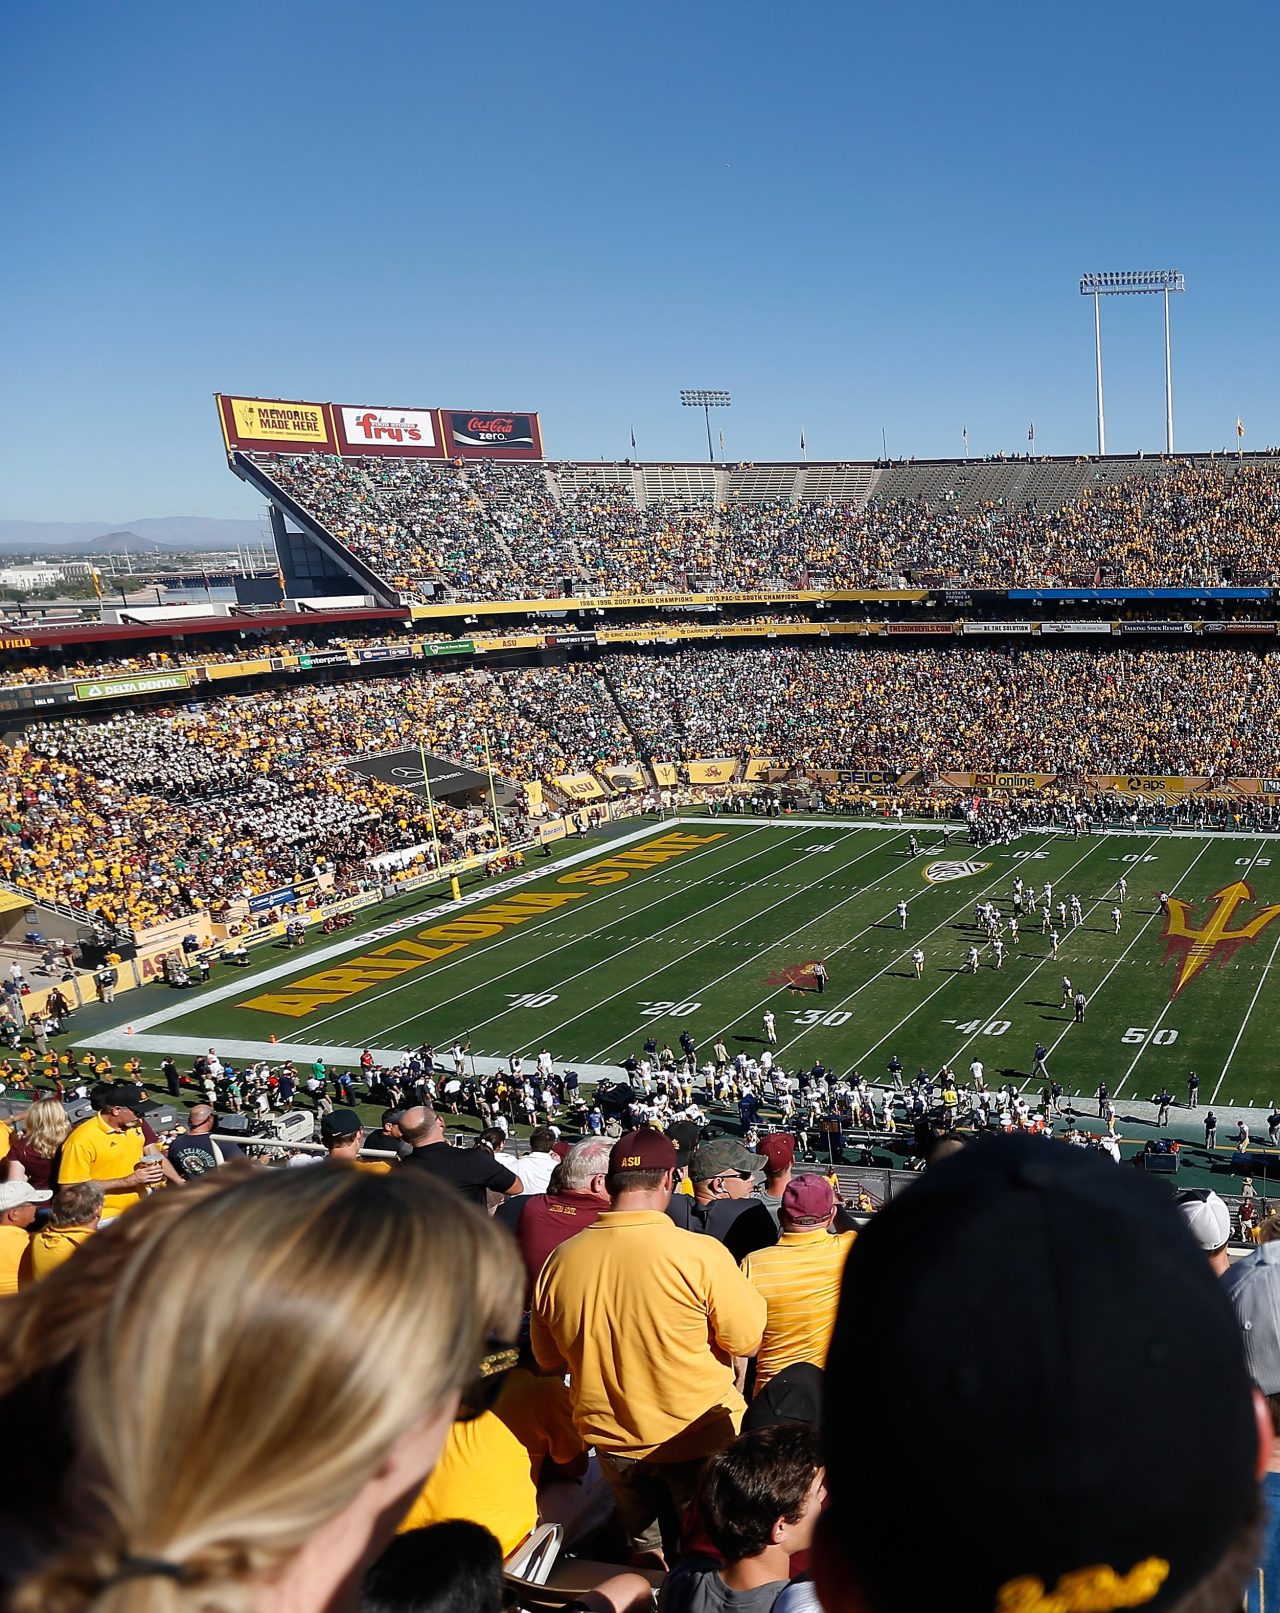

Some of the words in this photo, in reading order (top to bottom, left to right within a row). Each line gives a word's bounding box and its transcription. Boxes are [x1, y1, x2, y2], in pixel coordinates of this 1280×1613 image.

[257, 408, 319, 422] MEMORIES
[259, 418, 291, 430] MADE
[292, 420, 320, 432] HERE
[356, 413, 422, 442] fry's
[655, 596, 694, 604] CHAMPIONS
[888, 625, 952, 633] THESUNDEVILS.COM
[5, 638, 32, 648] FIELD
[302, 654, 348, 667] enterprise
[104, 682, 137, 696] DELTA
[137, 677, 180, 692] DENTAL
[837, 771, 898, 784] GEICO
[975, 774, 996, 785] ASU
[998, 774, 1035, 786] online
[1143, 779, 1166, 791] aps
[570, 782, 595, 794] ASU
[556, 831, 730, 887] STATE
[1234, 857, 1272, 866] 50
[405, 870, 435, 888] GEICO
[249, 896, 270, 907] CASINO
[269, 889, 292, 903] ARIZONA
[321, 902, 352, 917] GEICO
[352, 892, 382, 907] GEICO
[354, 905, 449, 943] SALUTE
[480, 863, 564, 896] SERVICE
[235, 890, 590, 1018] ARIZONA
[520, 993, 559, 1008] 10
[640, 1002, 702, 1018] 20
[793, 1010, 853, 1027] 30
[956, 1020, 1012, 1036] 40
[1121, 1027, 1179, 1046] 50
[620, 1155, 642, 1168] ASU
